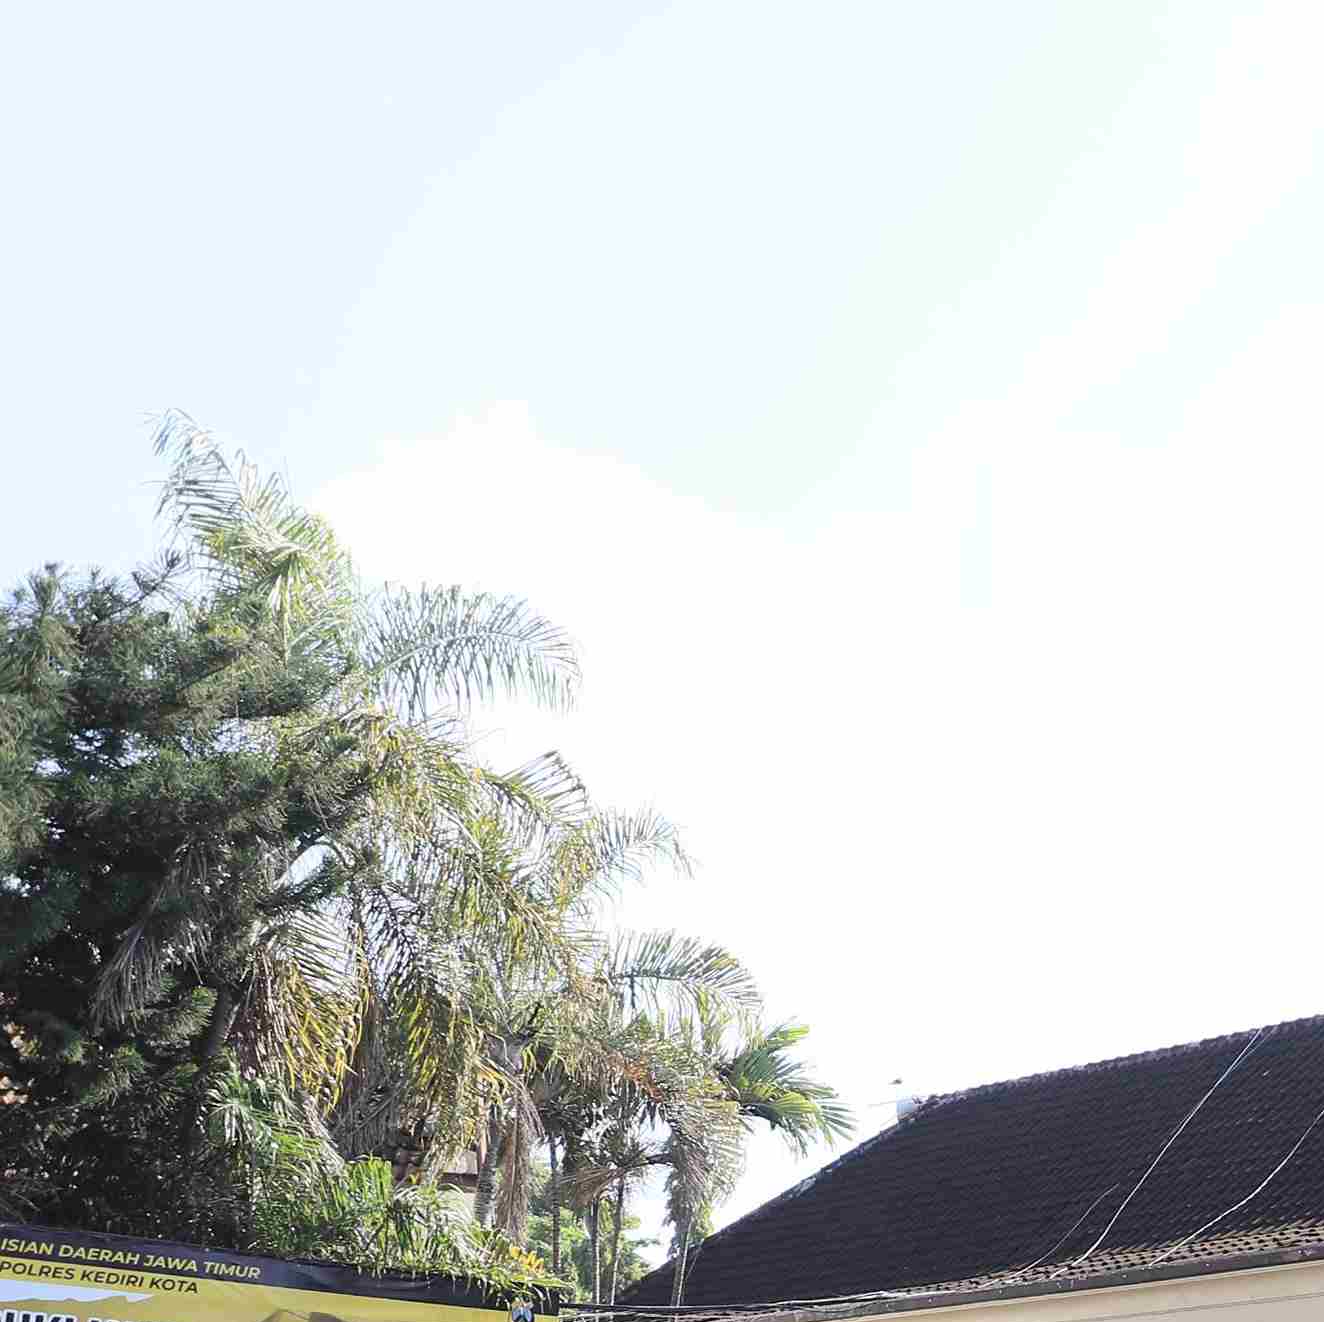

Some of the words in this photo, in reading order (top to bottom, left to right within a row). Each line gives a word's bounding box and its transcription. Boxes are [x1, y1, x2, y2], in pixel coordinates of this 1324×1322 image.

[1, 1238, 54, 1256] ISIAN
[58, 1244, 140, 1265] DAERAH
[145, 1254, 198, 1272] JAWA
[203, 1261, 262, 1279] TIMUR
[0, 1261, 75, 1281] POLRES
[80, 1270, 145, 1288] KEDIRI
[149, 1277, 199, 1294] KOTA
